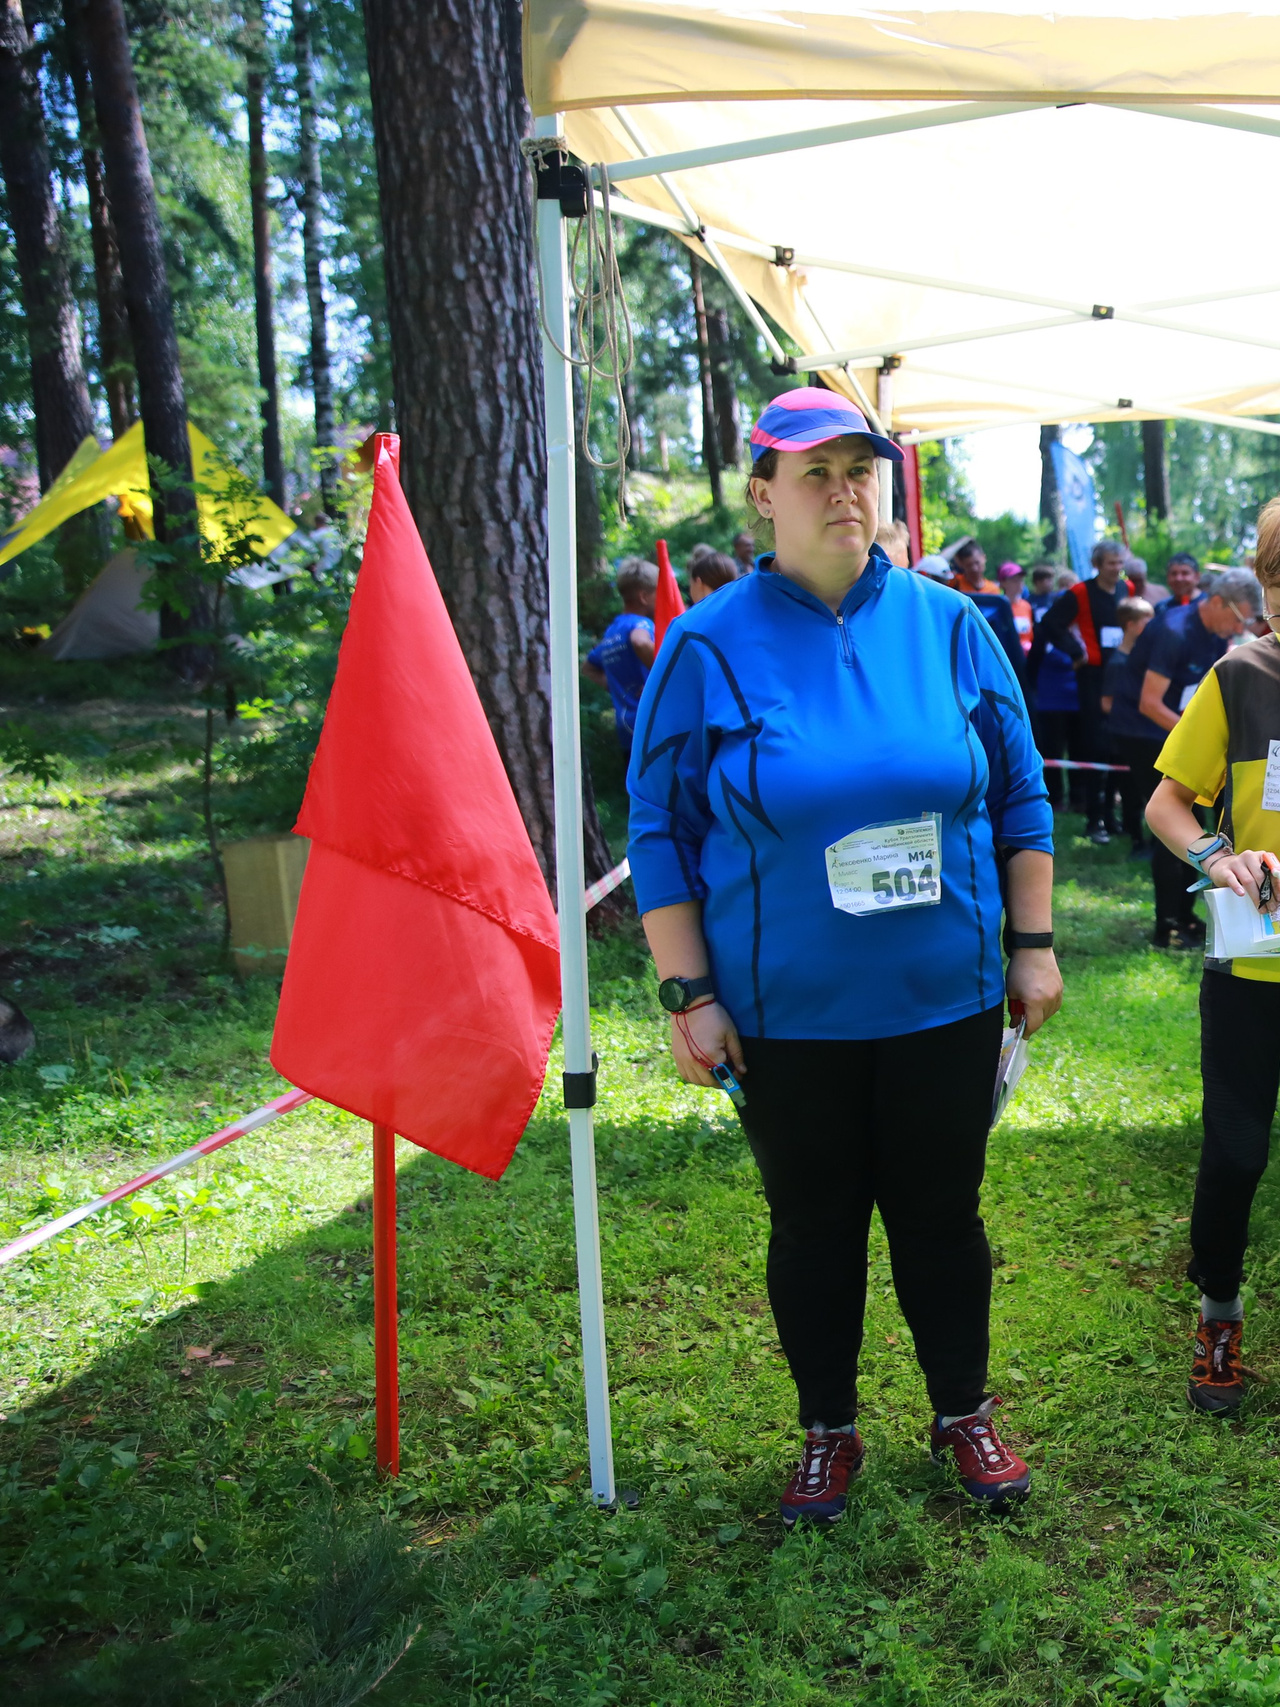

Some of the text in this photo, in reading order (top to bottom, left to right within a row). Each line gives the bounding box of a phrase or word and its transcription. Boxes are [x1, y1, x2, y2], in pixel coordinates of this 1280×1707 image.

[873, 852, 899, 863] Марина
[908, 849, 934, 863] М14
[836, 886, 862, 895] 12:04:00
[872, 864, 938, 905] 504
